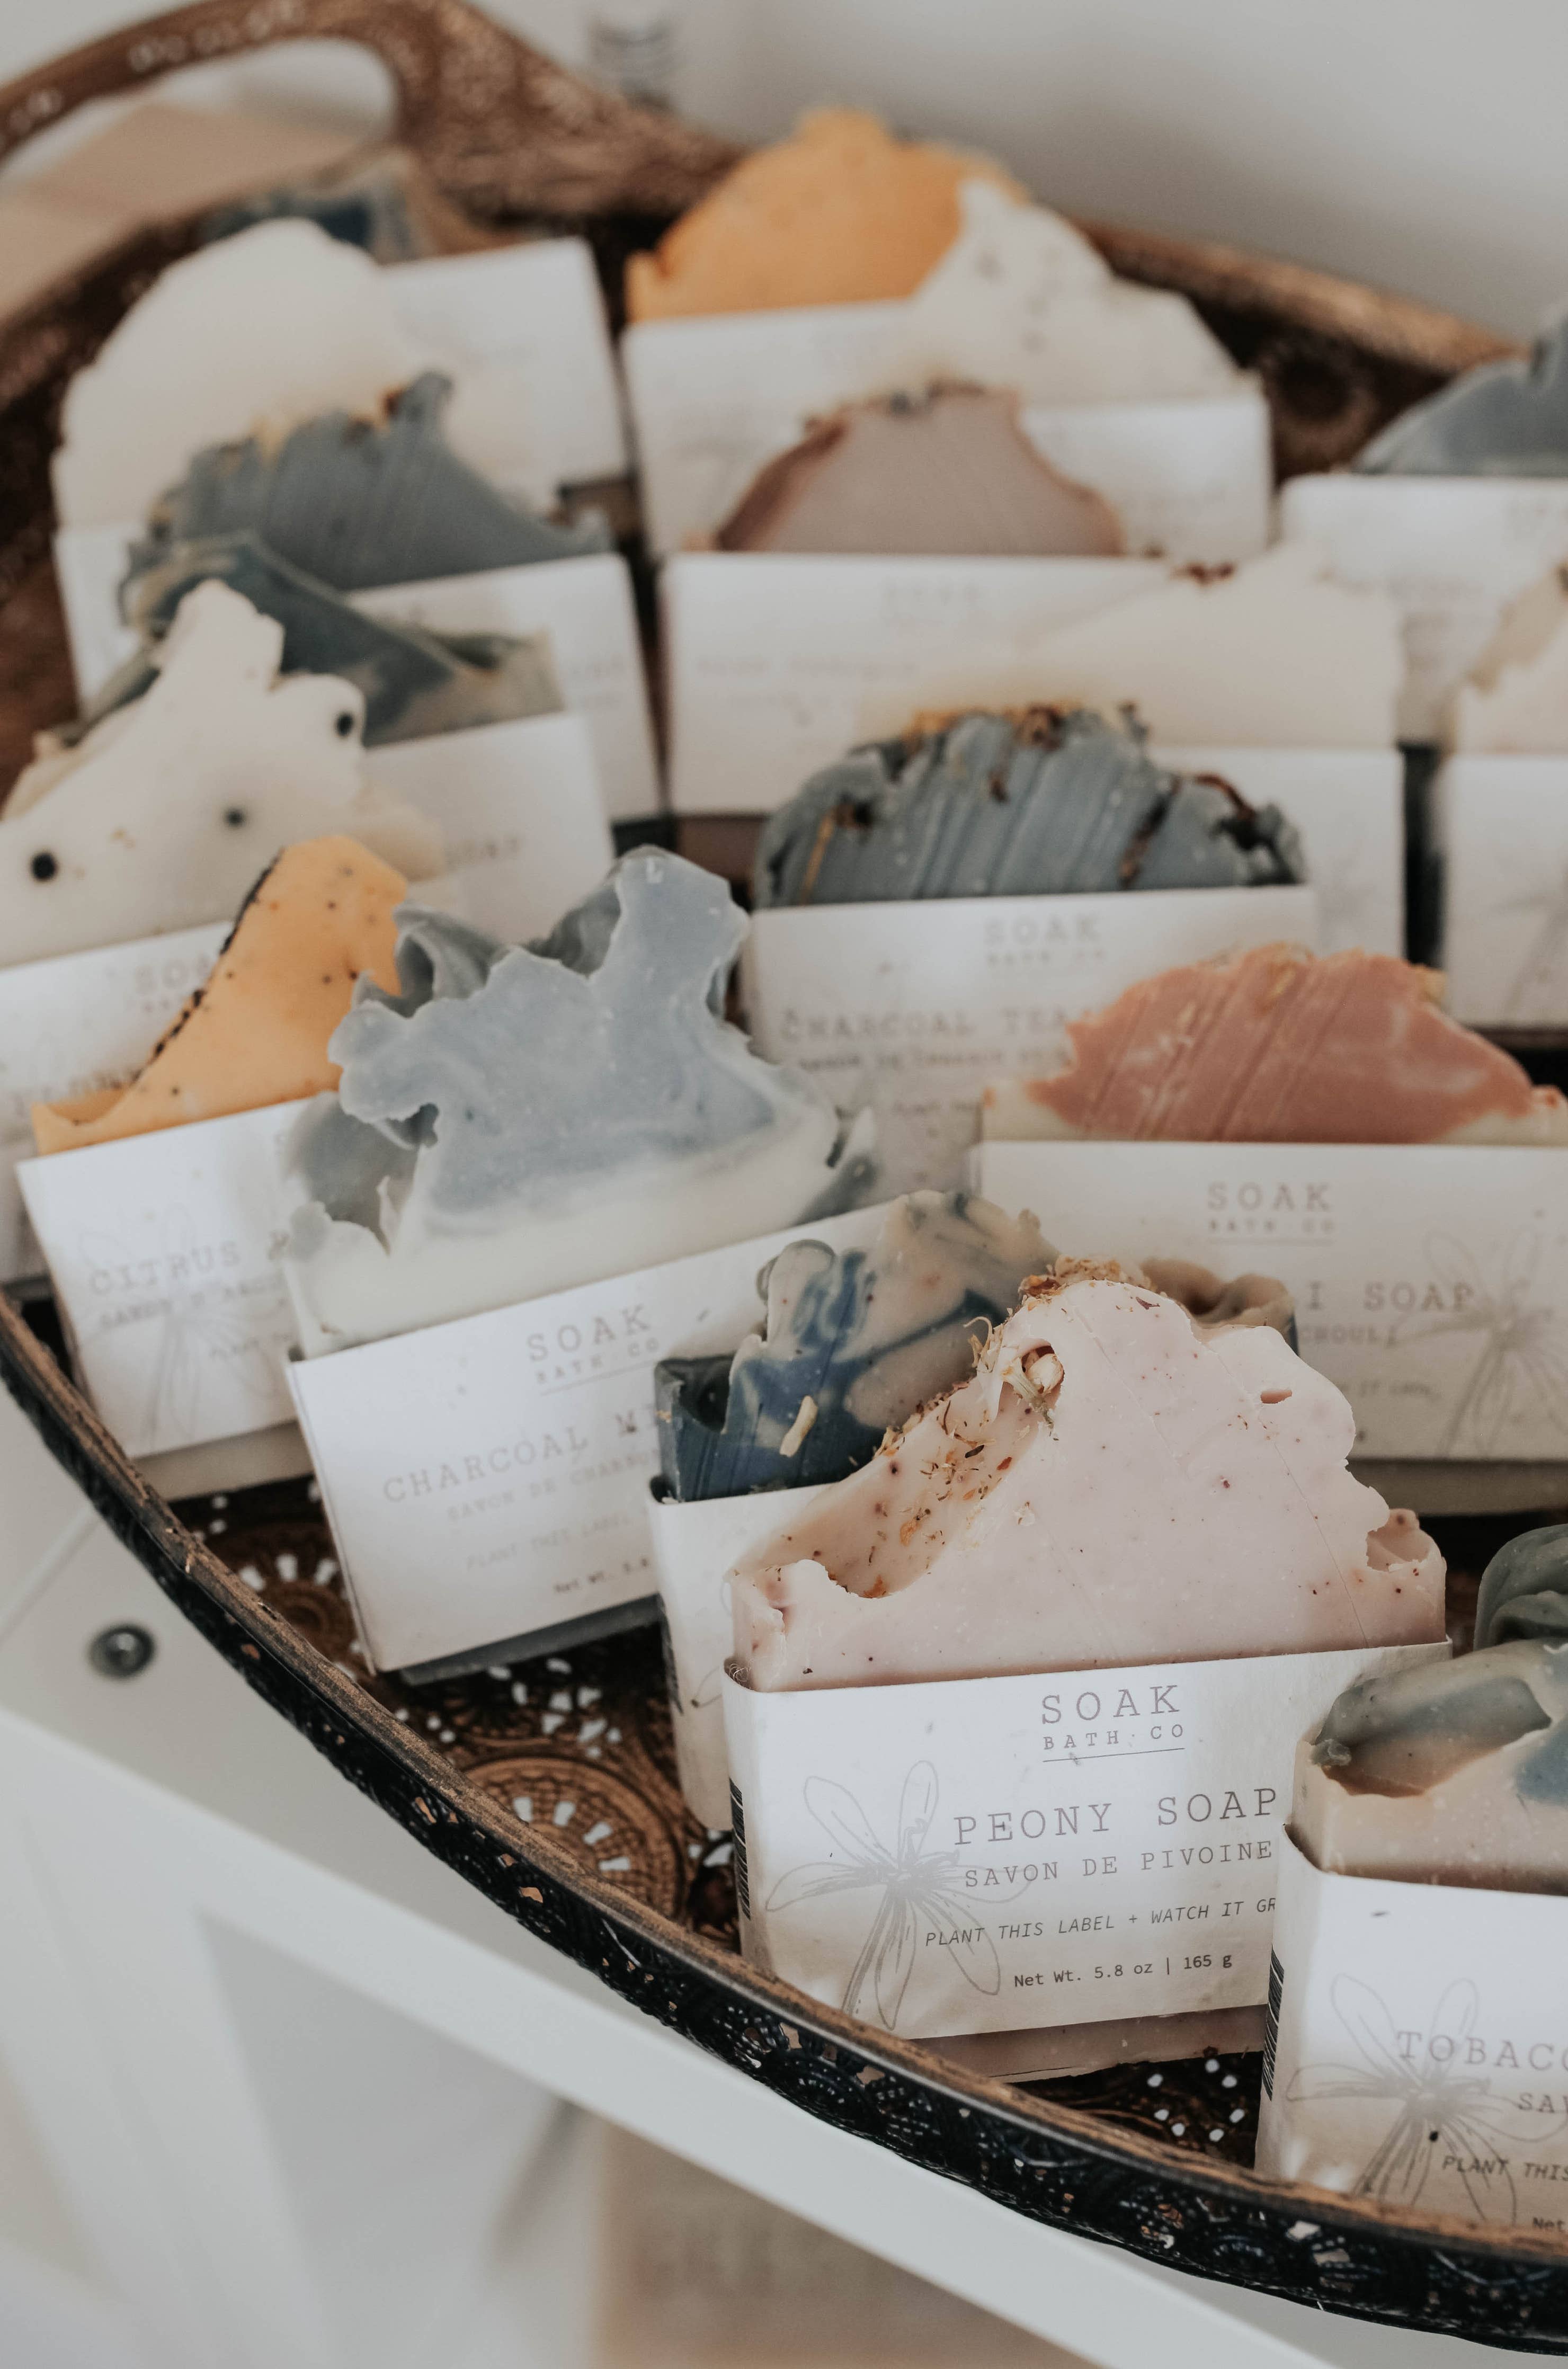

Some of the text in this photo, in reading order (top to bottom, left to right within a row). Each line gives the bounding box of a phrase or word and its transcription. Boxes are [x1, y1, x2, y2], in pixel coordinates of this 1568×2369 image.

[1207, 1181, 1332, 1212] SOAK
[90, 1241, 242, 1296] CITRUS
[1363, 1280, 1476, 1311] SOAP
[527, 1304, 651, 1362] SOAK
[382, 1426, 589, 1503] CHARCOAL
[1041, 1685, 1180, 1725] SOAK
[954, 1788, 1276, 1845] PEONY SOAP
[965, 1841, 1272, 1887] SAVON DE PIVOINE
[925, 1927, 985, 1946] PLANT
[999, 1922, 1044, 1939] THIS
[1058, 1914, 1115, 1934] LABEL
[1129, 1914, 1138, 1925] +
[1151, 1904, 1209, 1924] WATCH
[1221, 1901, 1244, 1917] IT
[1014, 1973, 1044, 1987] Net
[1053, 1969, 1082, 1983] Wt.
[1094, 1963, 1126, 1979] 5.8
[1133, 1963, 1153, 1974] oz
[1184, 1954, 1212, 1970] 165
[1222, 1955, 1233, 1969] g
[1397, 2030, 1568, 2071] TOBAC
[1518, 2092, 1568, 2115] SA
[1442, 2155, 1510, 2176] PLANT
